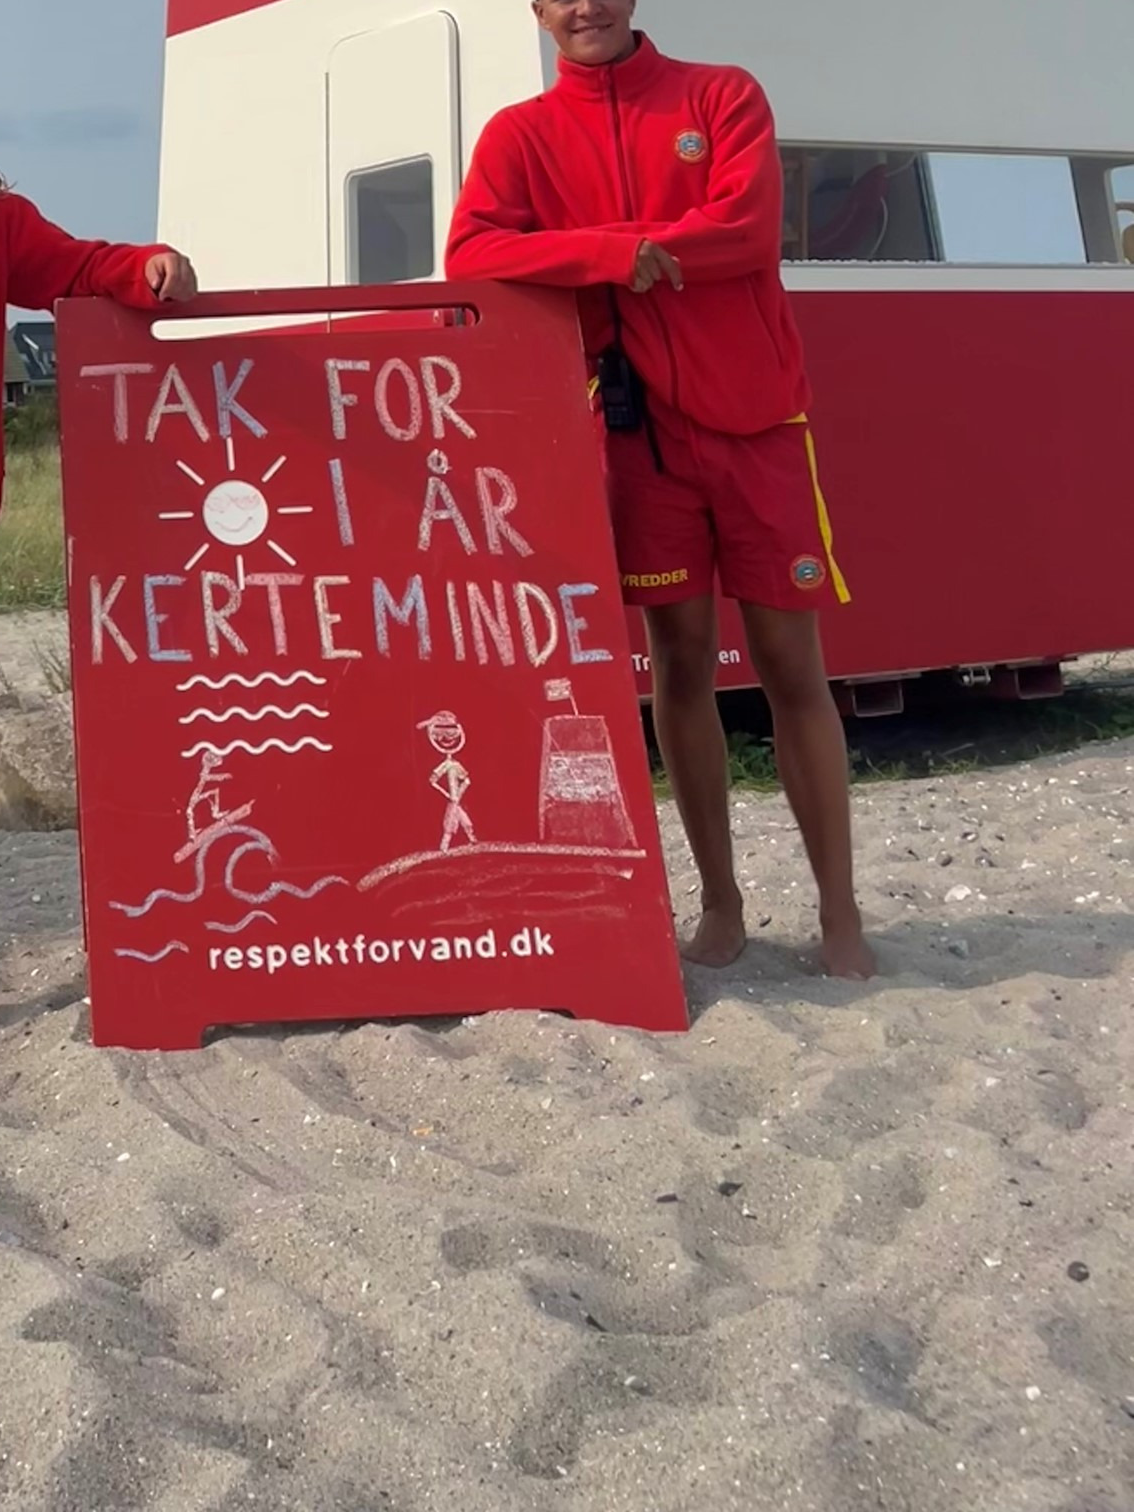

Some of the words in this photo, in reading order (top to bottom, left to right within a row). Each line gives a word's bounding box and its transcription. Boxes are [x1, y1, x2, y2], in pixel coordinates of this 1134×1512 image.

[80, 358, 268, 443] TAK
[325, 355, 477, 442] FOR
[328, 458, 355, 546] I
[418, 448, 535, 558] ÅR
[90, 571, 614, 667] KERTEMINDE
[208, 926, 555, 974] respektforvand.dk
